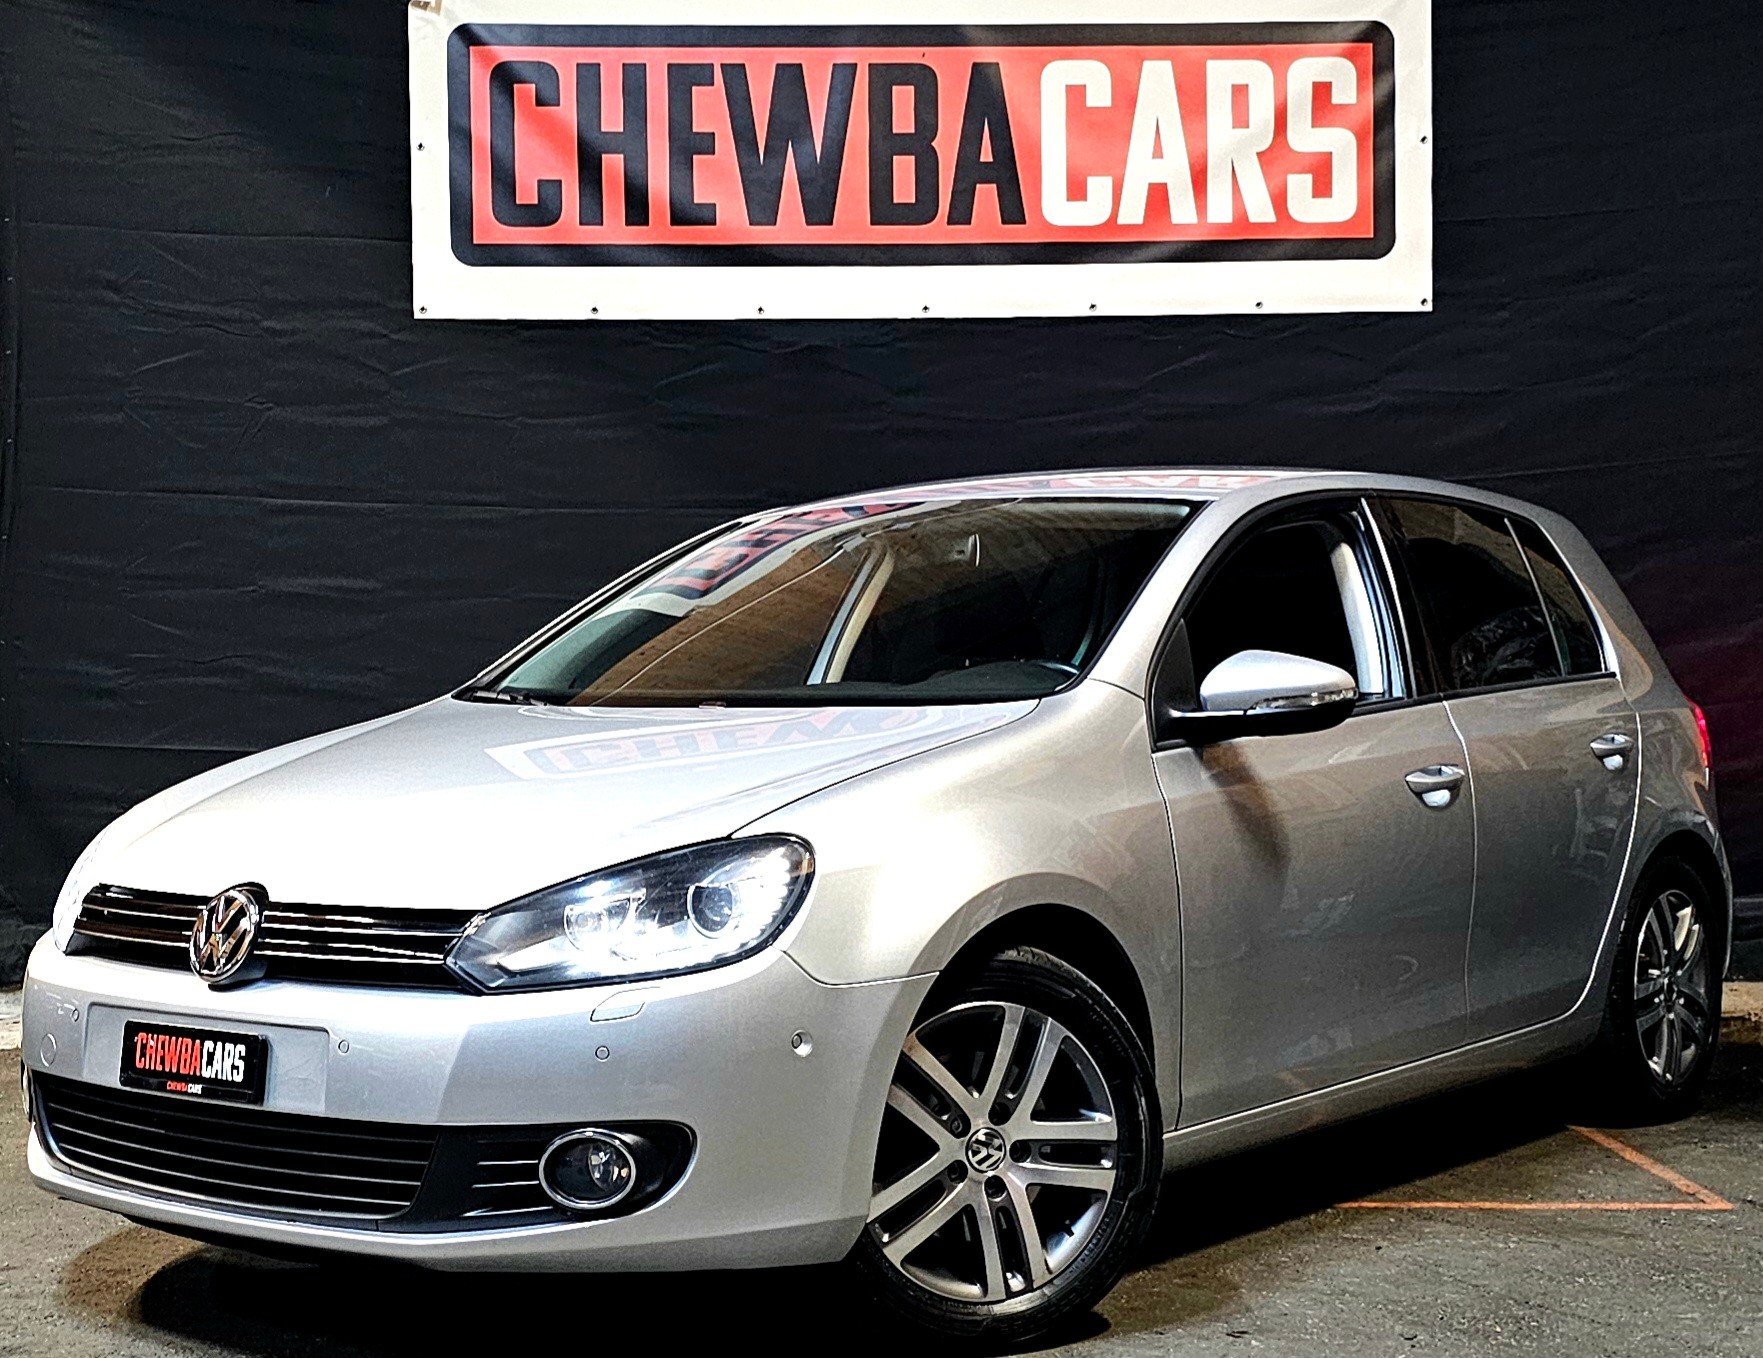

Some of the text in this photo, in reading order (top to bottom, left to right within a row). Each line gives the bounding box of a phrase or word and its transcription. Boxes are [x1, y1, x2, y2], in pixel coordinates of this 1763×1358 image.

[488, 56, 1359, 227] CHEWBACARS
[193, 890, 255, 980] VW
[135, 1032, 246, 1082] CHEWBACARS
